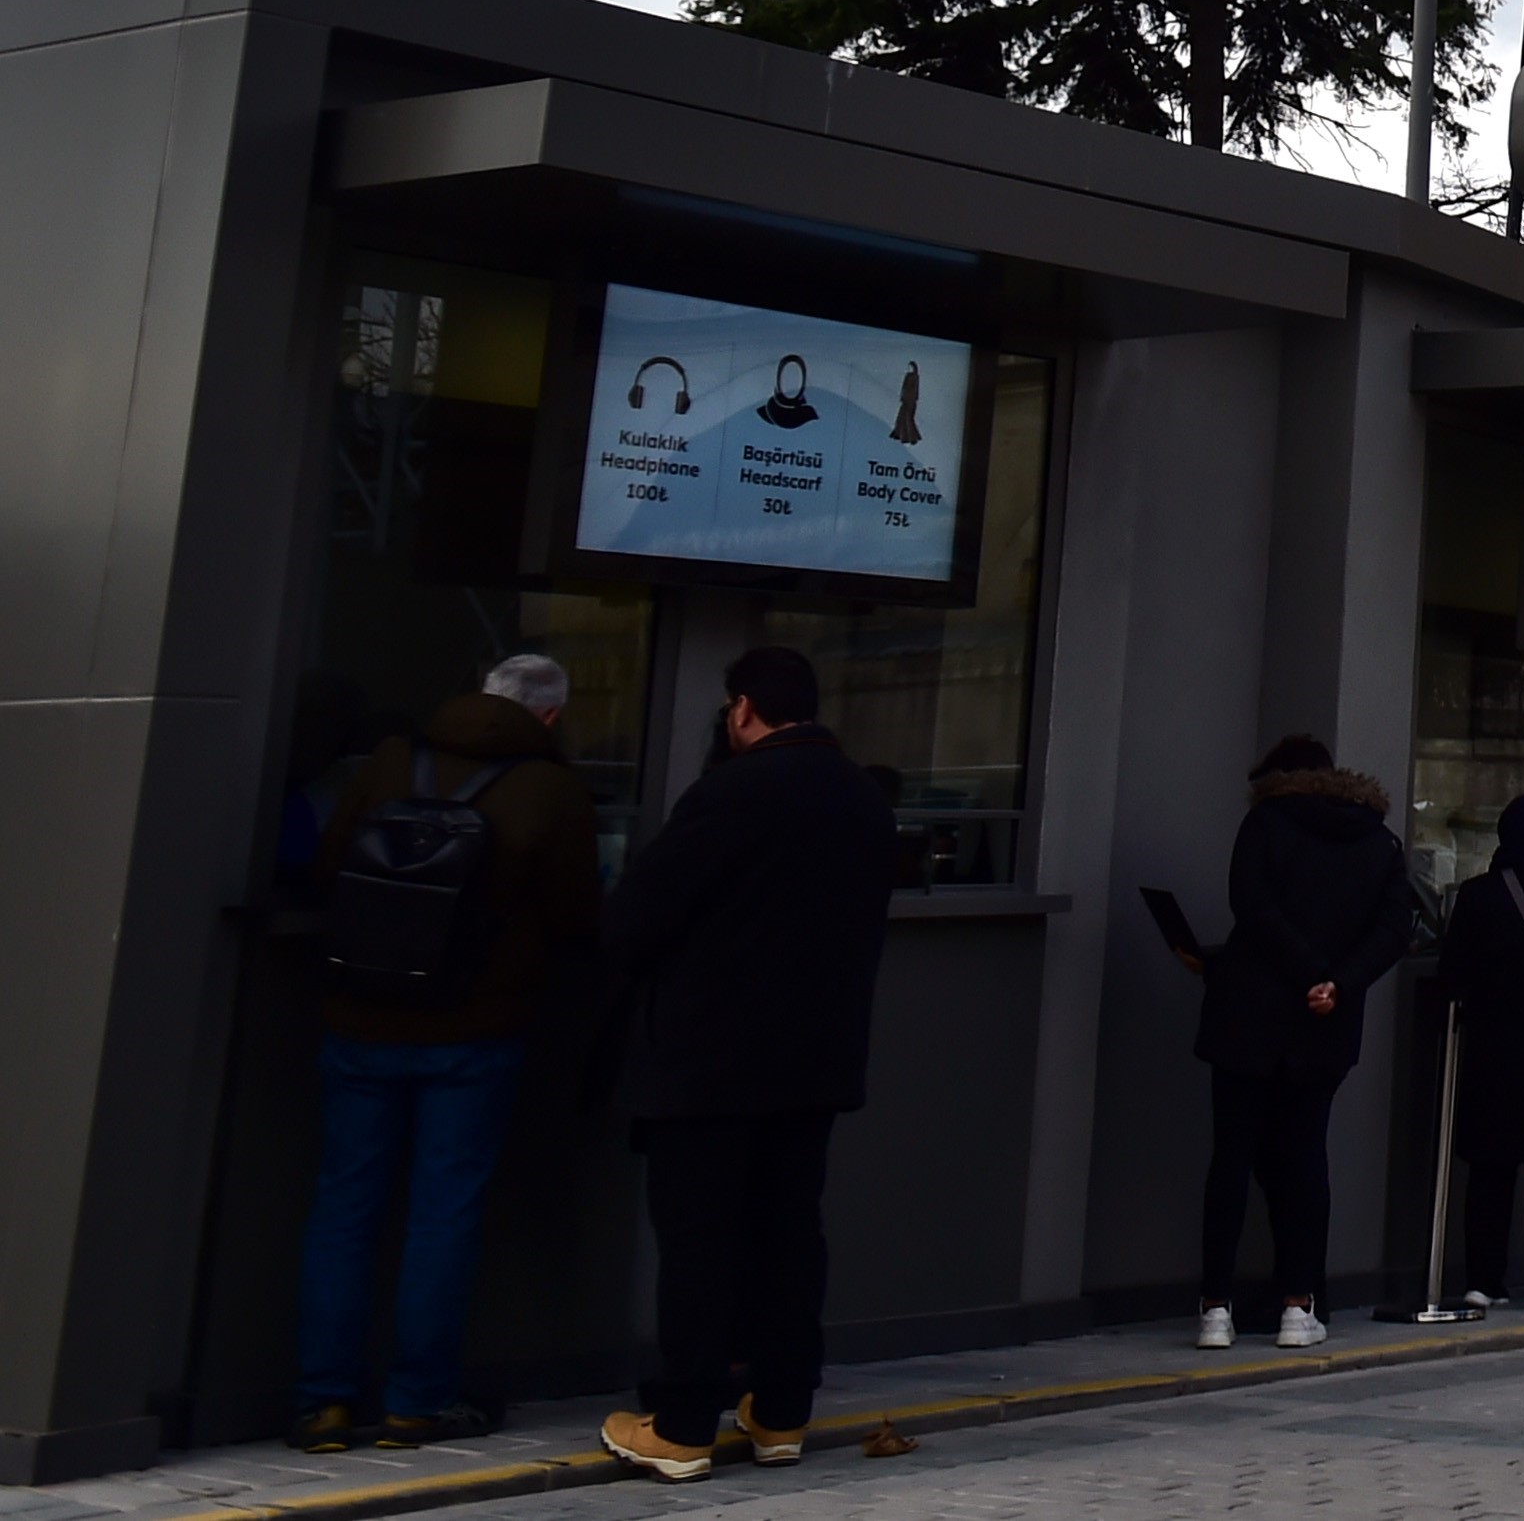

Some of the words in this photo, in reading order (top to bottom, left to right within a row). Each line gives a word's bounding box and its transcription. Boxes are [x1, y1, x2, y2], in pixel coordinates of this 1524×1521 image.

[618, 429, 689, 453] Kulaklık
[600, 452, 701, 477] Headphone
[742, 445, 823, 468] Başörtüsü
[739, 468, 823, 491] Headscarf
[867, 460, 899, 478] Tam
[902, 462, 936, 483] Örtü
[857, 481, 896, 503] Body
[899, 488, 943, 506] Cover
